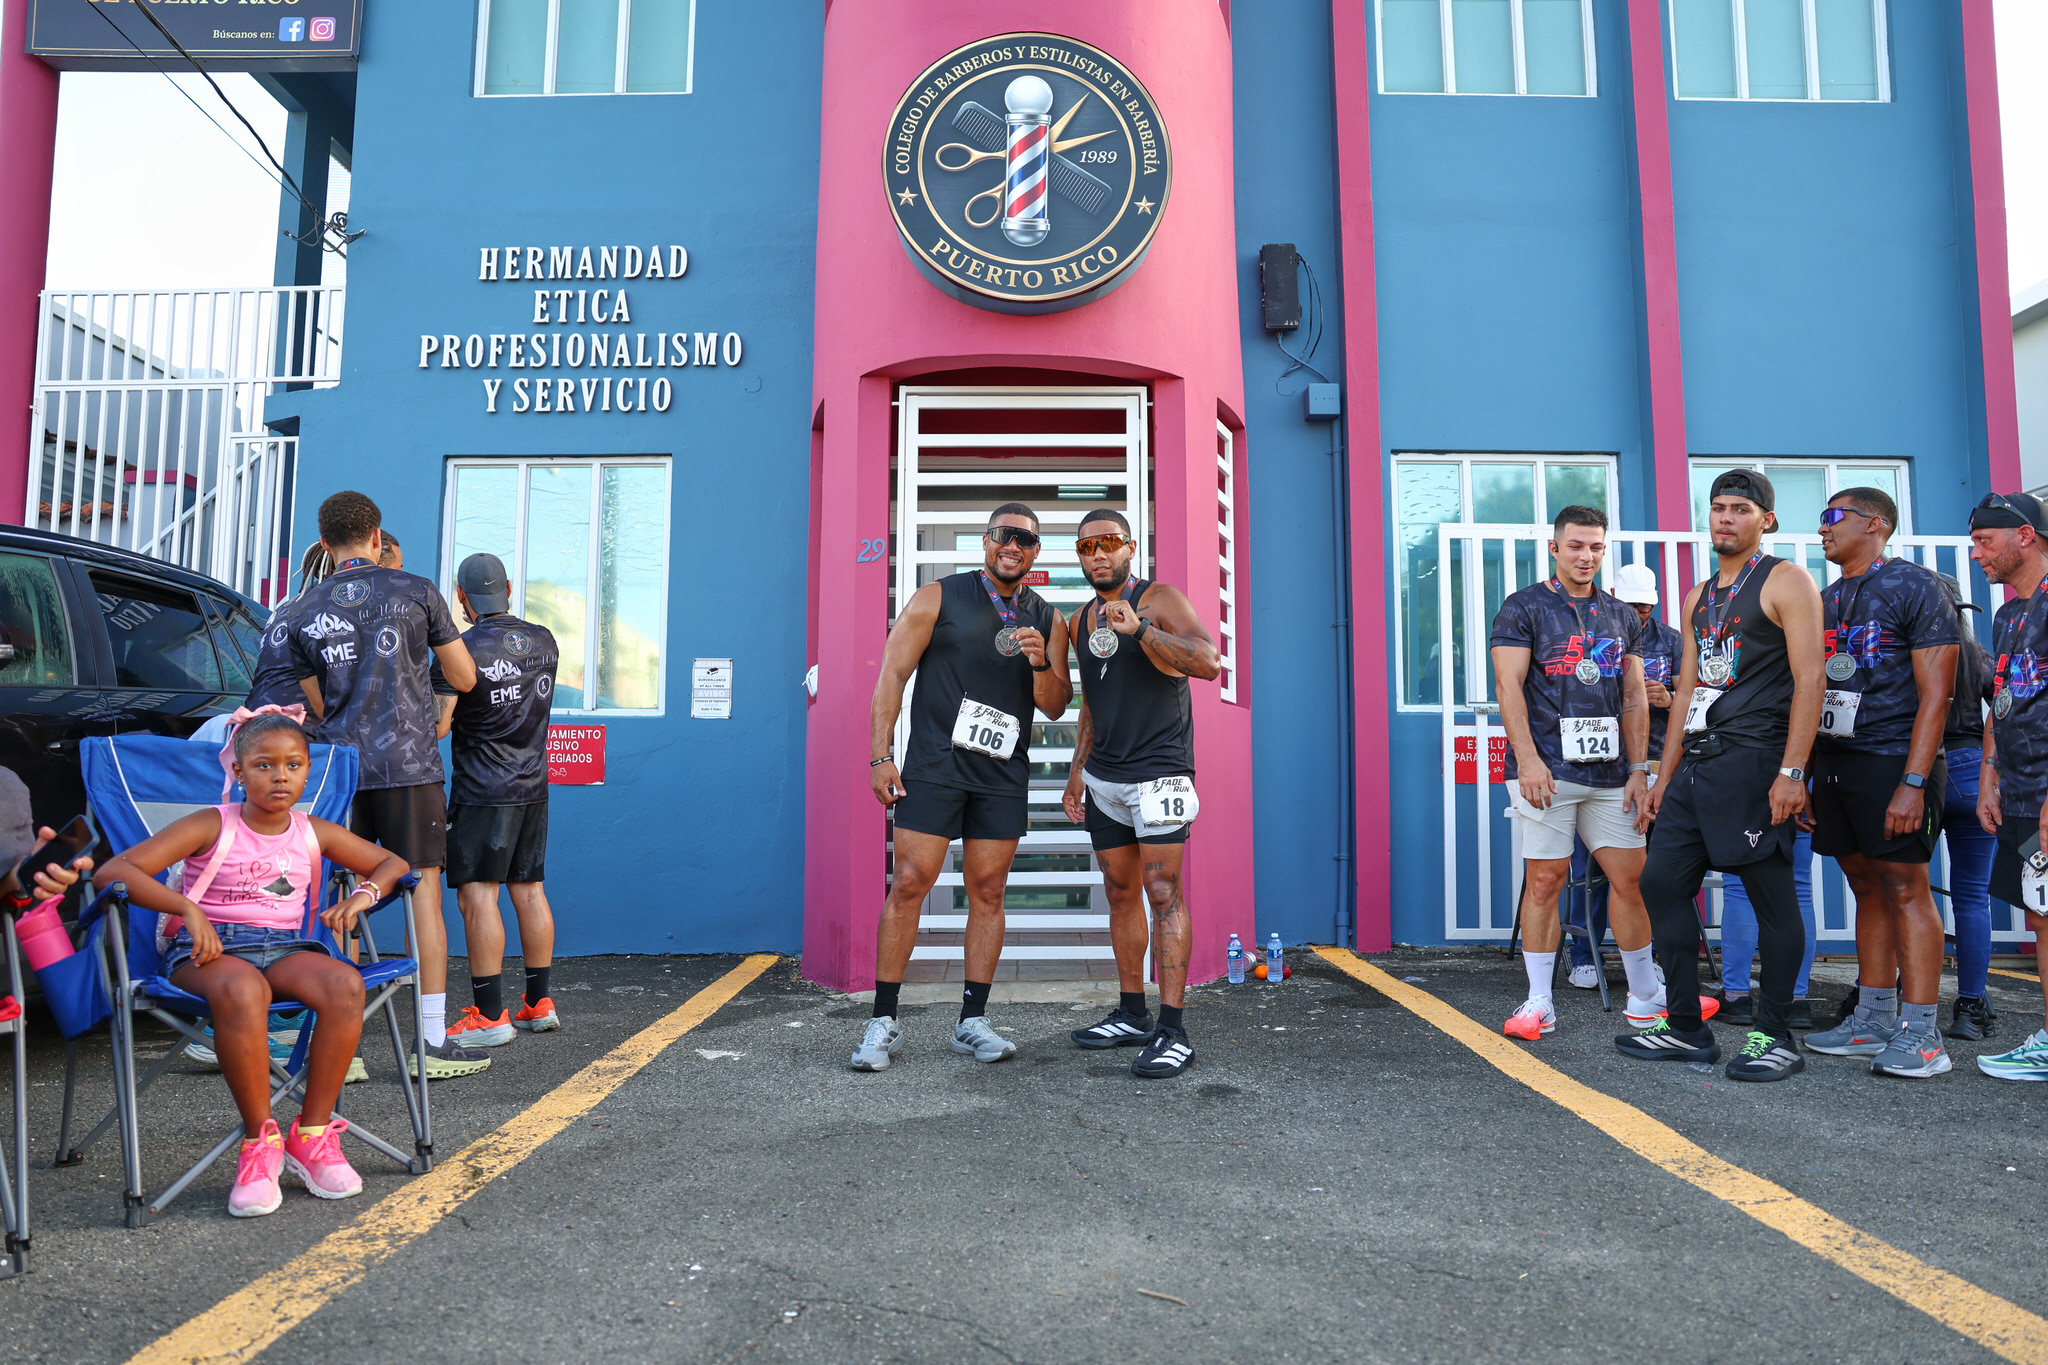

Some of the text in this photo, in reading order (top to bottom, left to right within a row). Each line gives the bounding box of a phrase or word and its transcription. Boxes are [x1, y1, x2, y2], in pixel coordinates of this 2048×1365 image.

[213, 29, 257, 39] Búscanos
[896, 46, 1160, 175] COLEGIO DE BARBEROS Y ESTILISTAS EN BARBERÍA
[1079, 150, 1118, 164] 1989
[479, 245, 688, 280] HERMANDAD
[929, 238, 1118, 288] PUERTO RICO
[533, 289, 630, 323] ETICA
[418, 332, 742, 368] PROFESIONALISMO
[483, 377, 672, 413] Y SERVICIO
[857, 538, 886, 563] 29
[1545, 664, 1577, 677] FAD
[490, 685, 522, 704] EME
[983, 707, 1005, 720] FADE
[1819, 711, 1835, 729] 0
[991, 719, 1010, 729] RUN
[1582, 719, 1602, 727] FADE
[968, 724, 1005, 750] 106
[1576, 737, 1610, 754] 124
[548, 753, 592, 763] EGIADOS
[1455, 752, 1478, 762] PARA
[1160, 797, 1184, 816] 18
